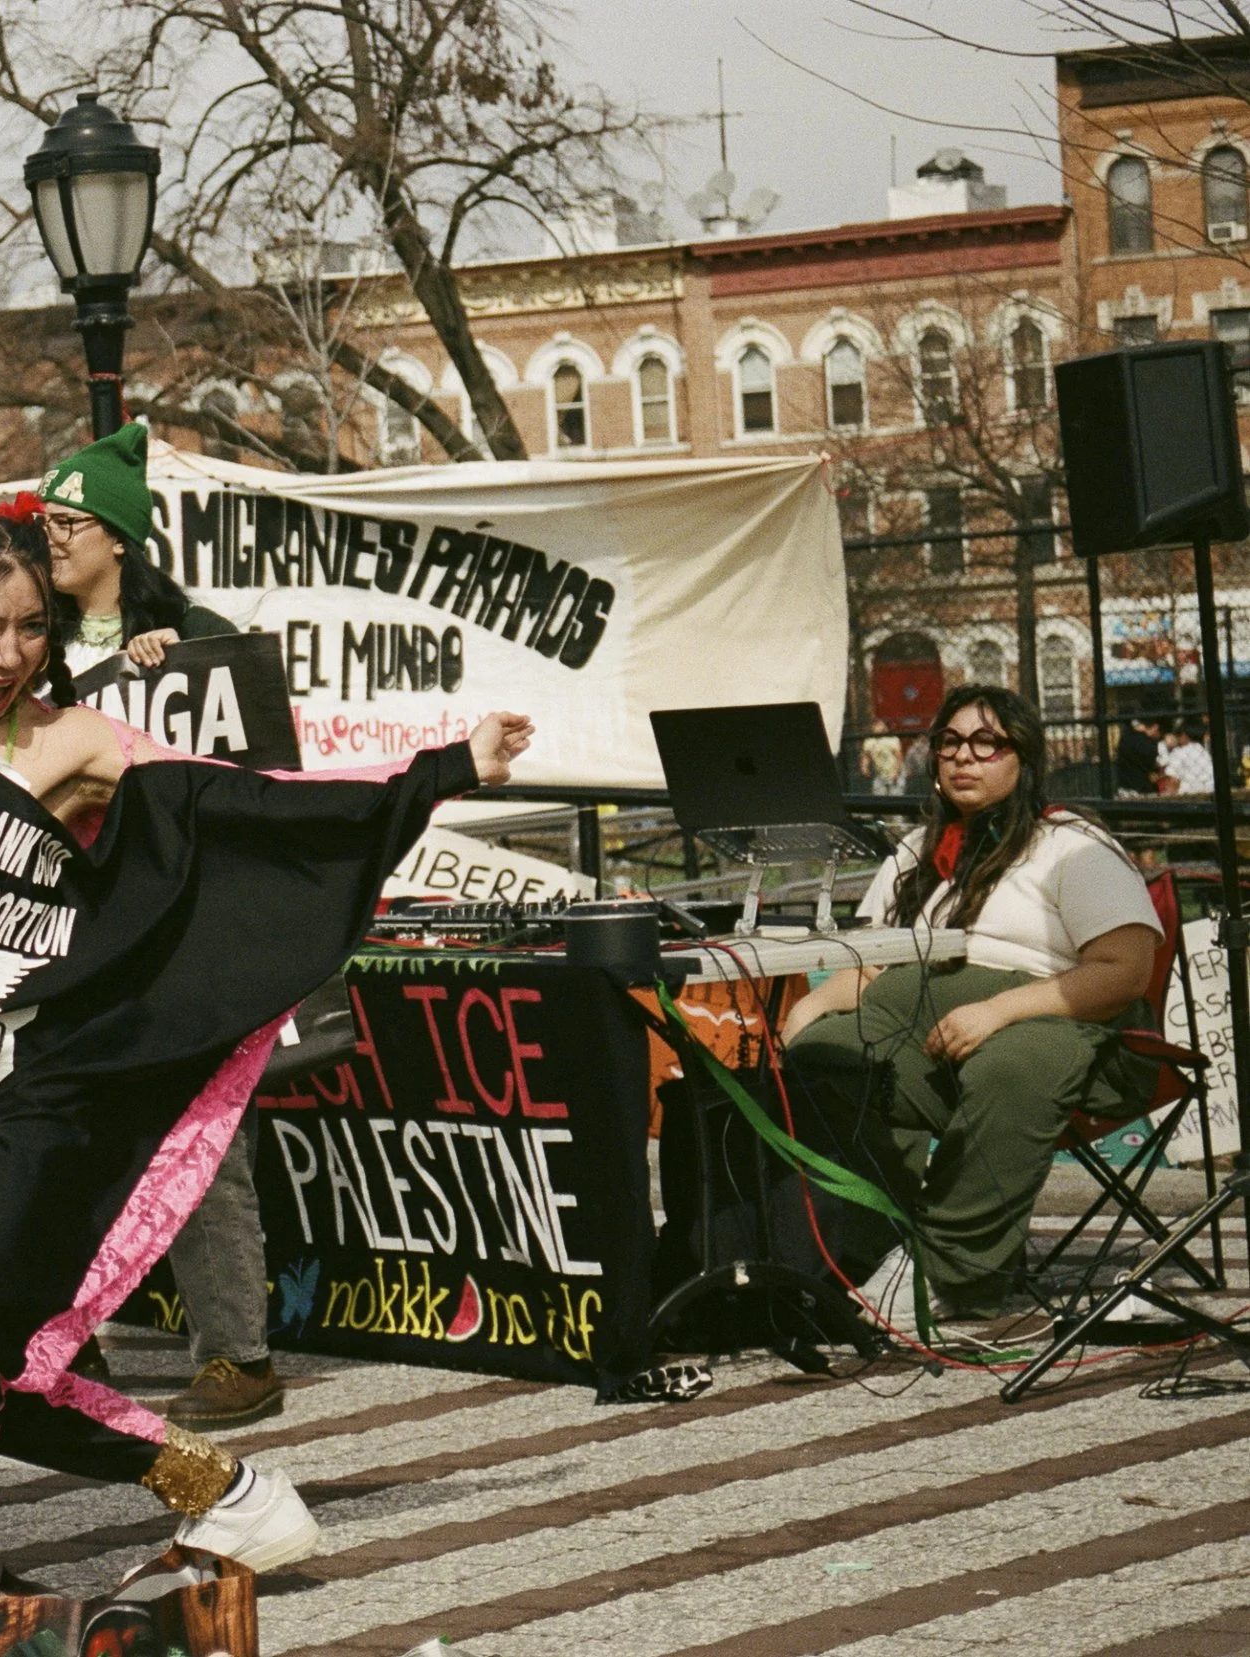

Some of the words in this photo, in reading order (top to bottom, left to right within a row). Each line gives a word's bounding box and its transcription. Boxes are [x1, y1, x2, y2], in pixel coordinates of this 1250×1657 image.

[287, 620, 331, 697] EL
[341, 620, 464, 701] MUNDO
[85, 666, 249, 756] NGA
[403, 985, 569, 1119] ICE
[272, 1118, 603, 1276] PALESTINE
[486, 1287, 538, 1345] no
